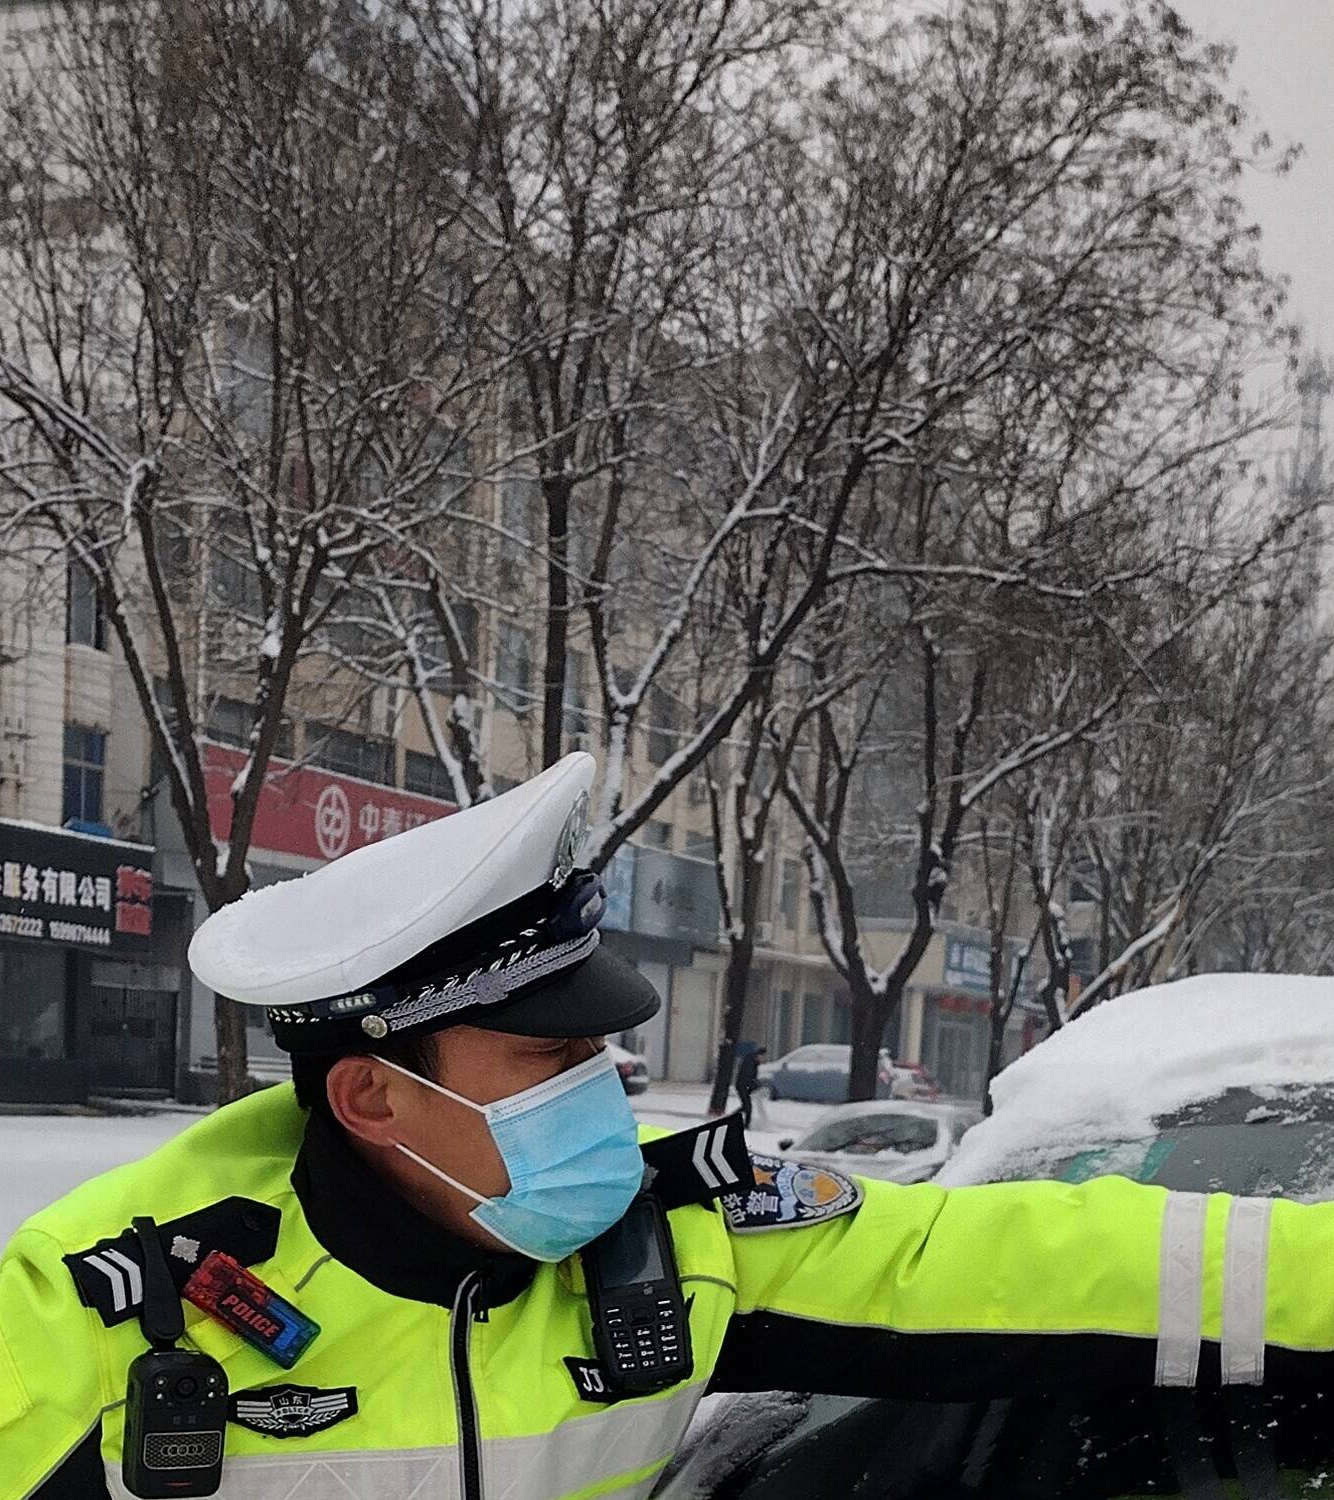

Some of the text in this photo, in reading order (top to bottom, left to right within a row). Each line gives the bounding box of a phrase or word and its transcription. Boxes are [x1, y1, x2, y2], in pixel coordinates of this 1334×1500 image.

[221, 1294, 280, 1339] POLICE
[578, 1366, 612, 1393] JJ
[278, 1396, 303, 1406] 山东
